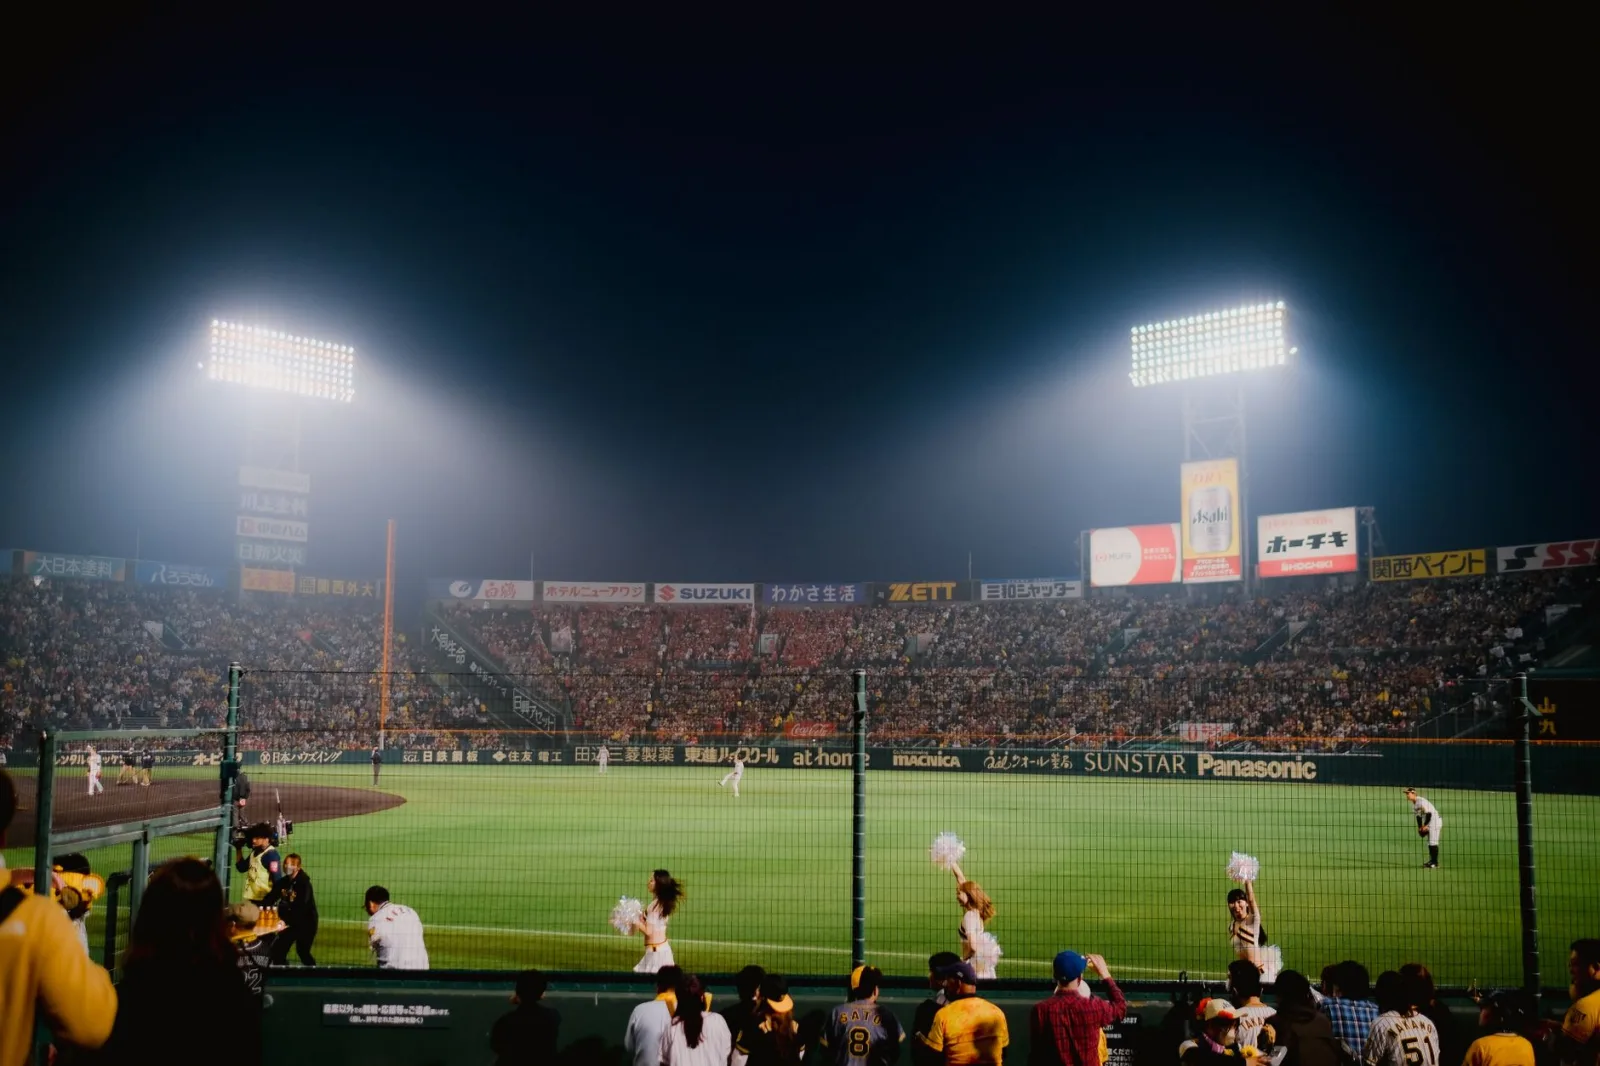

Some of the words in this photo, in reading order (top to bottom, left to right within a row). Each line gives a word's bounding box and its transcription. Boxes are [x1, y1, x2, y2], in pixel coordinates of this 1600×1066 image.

[1192, 506, 1229, 525] Asahi
[1270, 531, 1349, 554] ホーチキ
[36, 555, 112, 578] 大日本塗料
[1372, 552, 1484, 579] 関西ペイント
[546, 585, 643, 598] ホテルニューアワジ
[680, 587, 751, 600] SUZUKI
[772, 584, 857, 602] わかさ生活
[888, 582, 957, 601] ZETT
[431, 624, 466, 665] 大同生命
[272, 750, 343, 765] 日本ハウズイング
[508, 751, 563, 763] 住友電工
[792, 749, 814, 766] at
[1084, 752, 1187, 775] SUNSTAR
[1197, 754, 1317, 779] Panasonic
[840, 1009, 881, 1026] SATO
[1387, 1019, 1433, 1038] NAKANO
[849, 1026, 870, 1057] 8
[1401, 1035, 1436, 1066] 51
